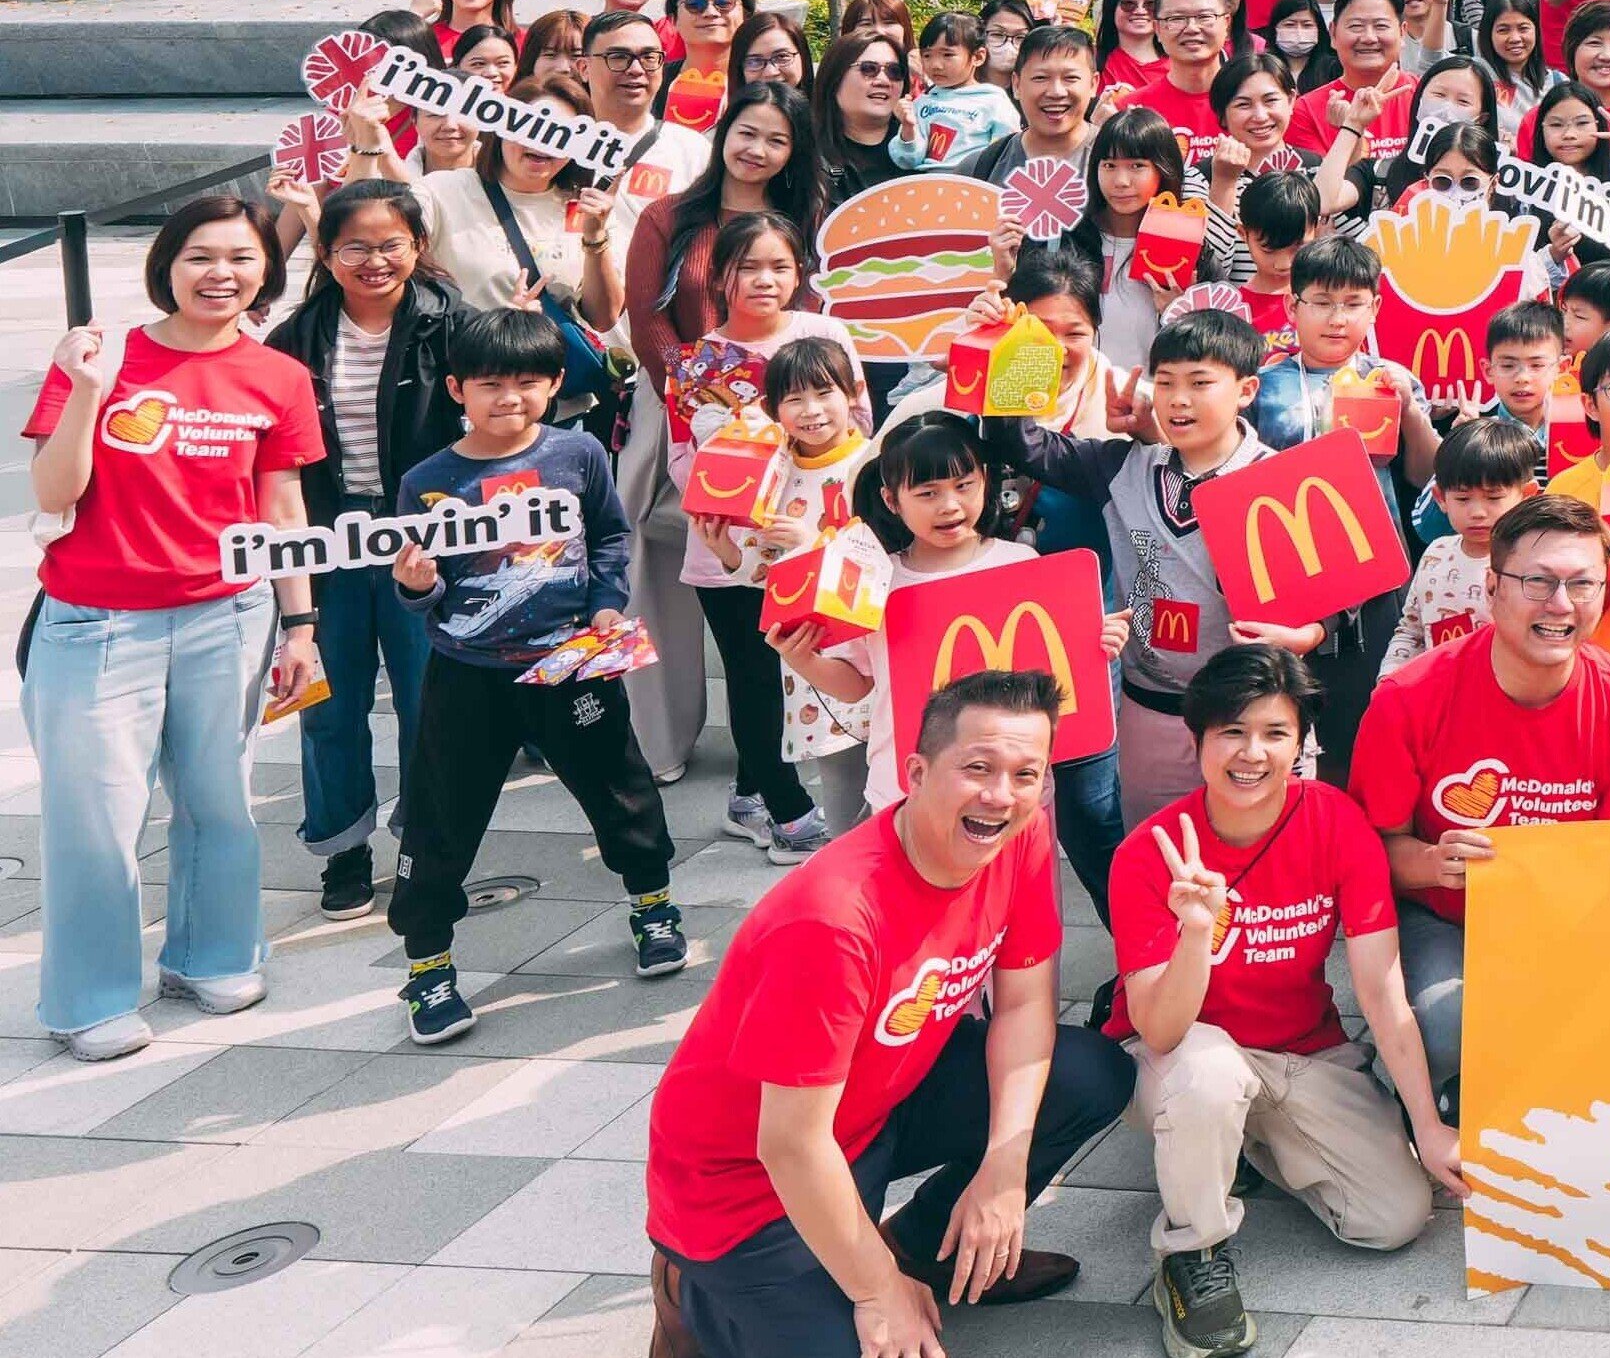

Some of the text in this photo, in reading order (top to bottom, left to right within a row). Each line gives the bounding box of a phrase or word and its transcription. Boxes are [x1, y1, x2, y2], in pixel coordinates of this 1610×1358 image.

[379, 54, 624, 169] i'm lovin' it
[1560, 179, 1605, 232] i'm
[176, 442, 230, 457] Team
[231, 497, 570, 575] i'm lovin' it
[1233, 893, 1334, 925] McDonald's
[1245, 913, 1332, 946] Volunteer
[1243, 946, 1296, 965] Team
